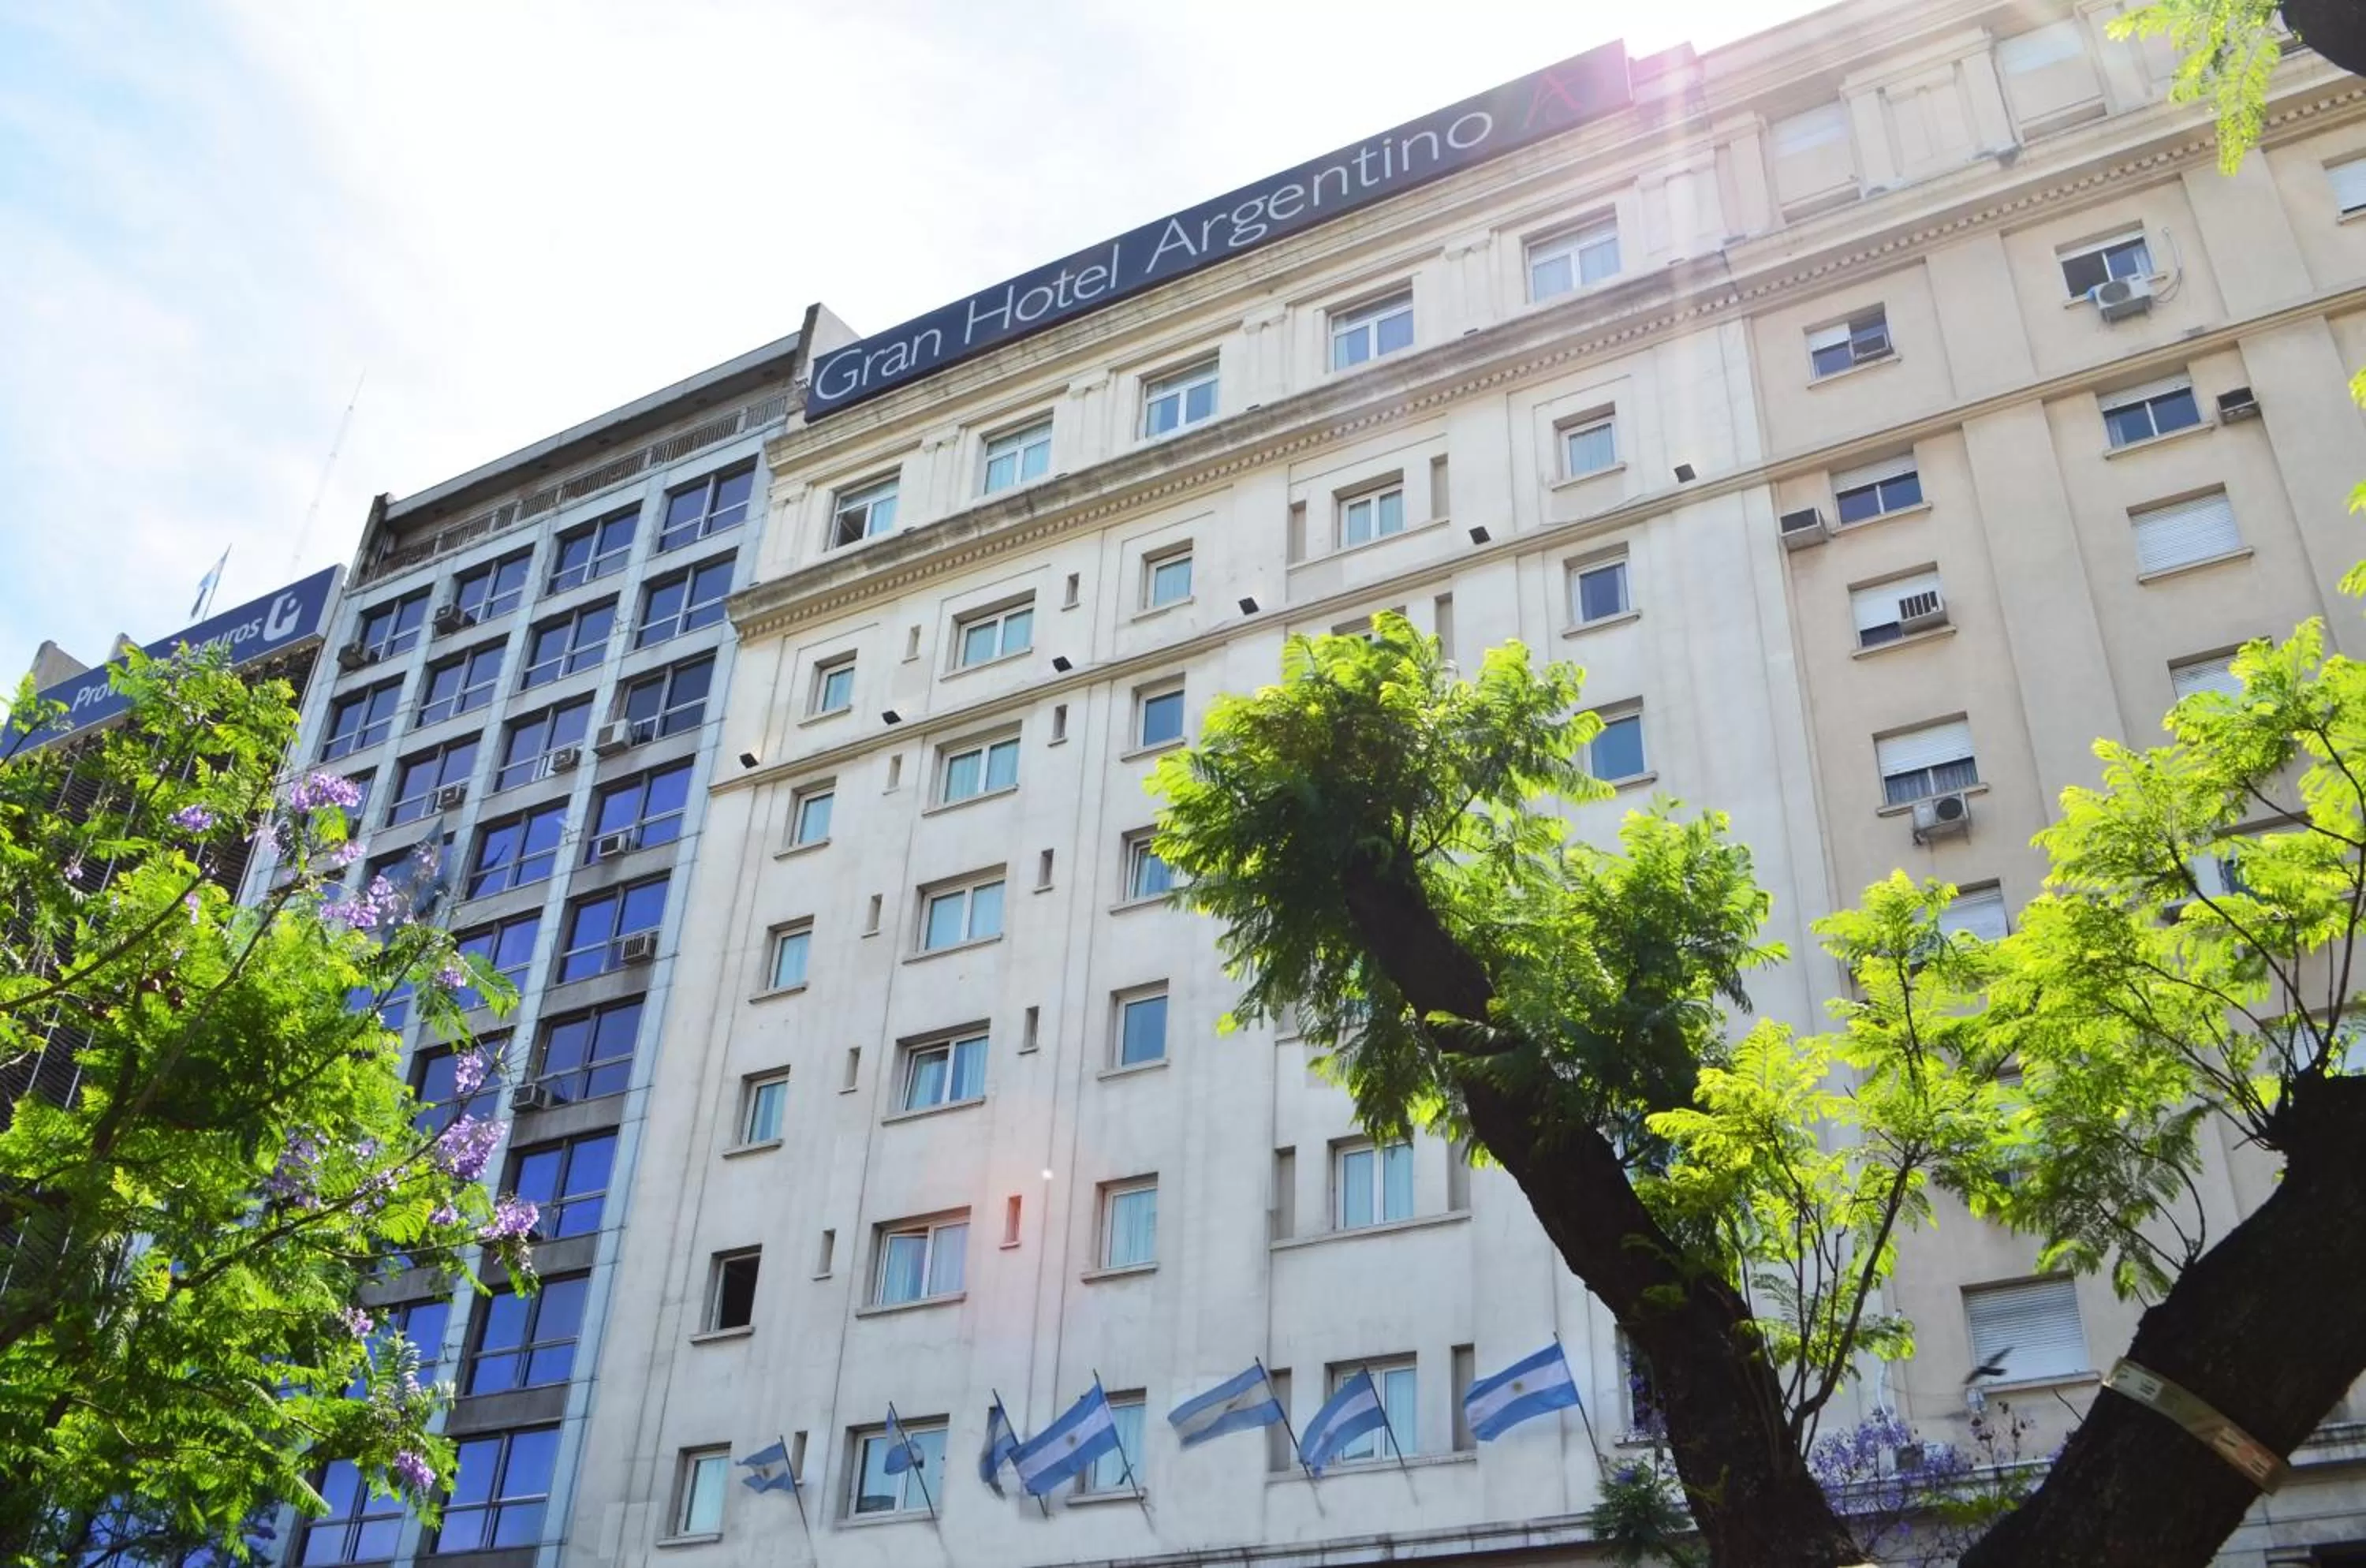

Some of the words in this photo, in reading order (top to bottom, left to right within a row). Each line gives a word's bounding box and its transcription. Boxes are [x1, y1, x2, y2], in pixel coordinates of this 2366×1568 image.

[815, 327, 941, 401] Gran
[964, 243, 1120, 345] Hotel
[1145, 110, 1494, 273] Argentino
